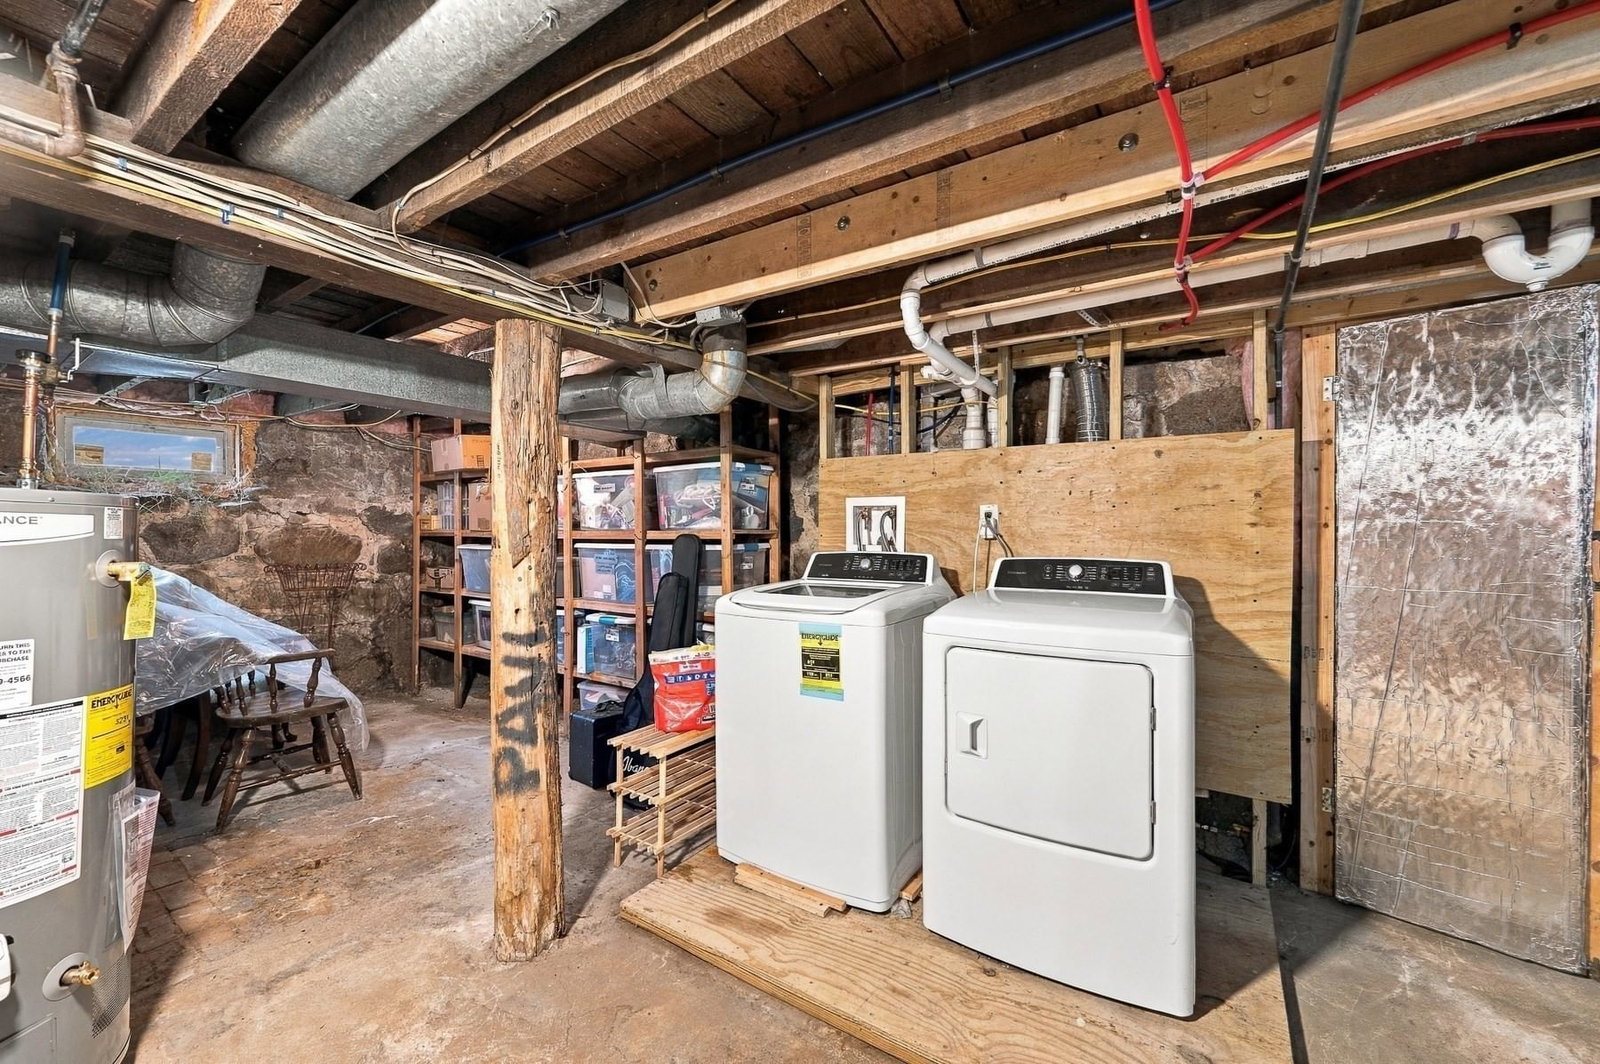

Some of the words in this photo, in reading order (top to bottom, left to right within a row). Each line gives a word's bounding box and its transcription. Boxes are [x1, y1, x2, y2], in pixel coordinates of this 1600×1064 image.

[0, 516, 39, 525] NCE
[495, 627, 547, 797] PAUL
[623, 755, 646, 773] Iban
